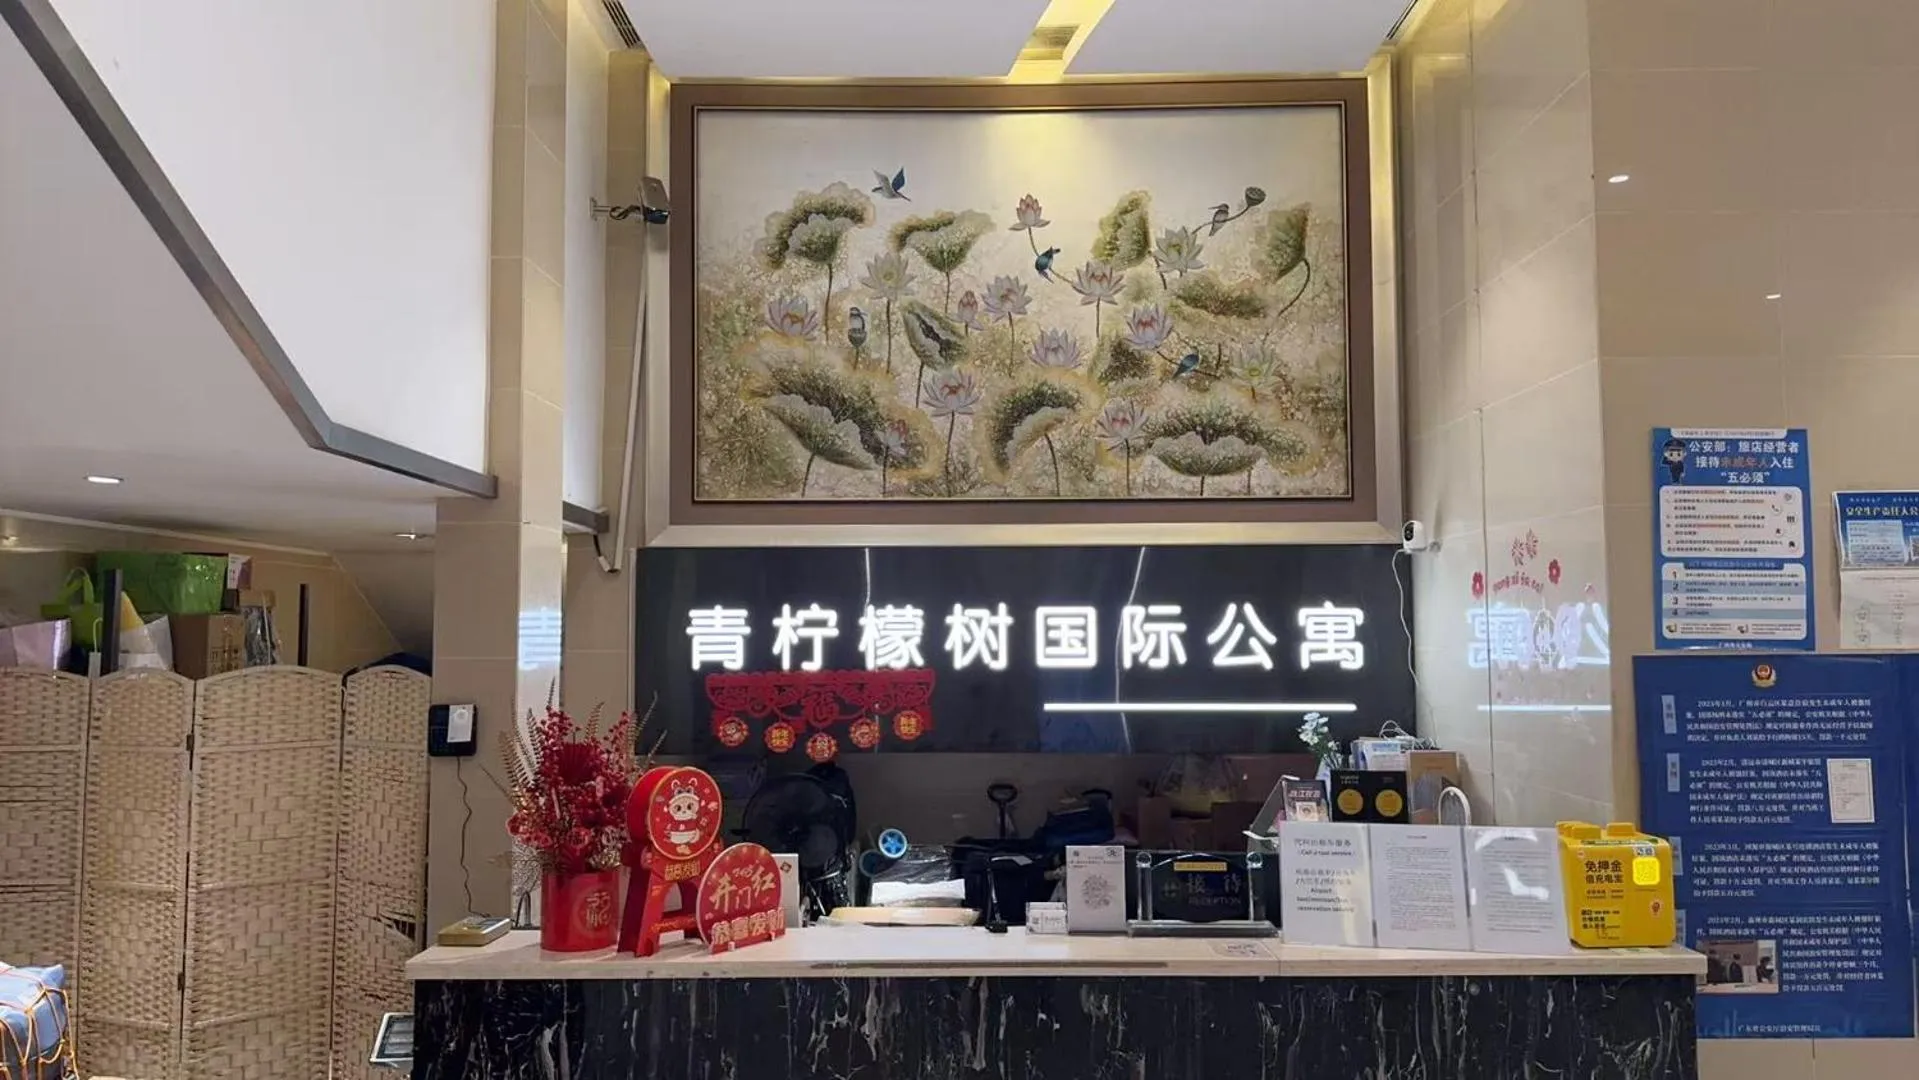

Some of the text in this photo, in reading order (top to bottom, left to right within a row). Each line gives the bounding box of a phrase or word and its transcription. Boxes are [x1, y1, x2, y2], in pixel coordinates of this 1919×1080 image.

[685, 601, 1366, 672] 青柠檬树国际公寓
[709, 863, 777, 914] 开门红
[1584, 859, 1623, 873] 免押金
